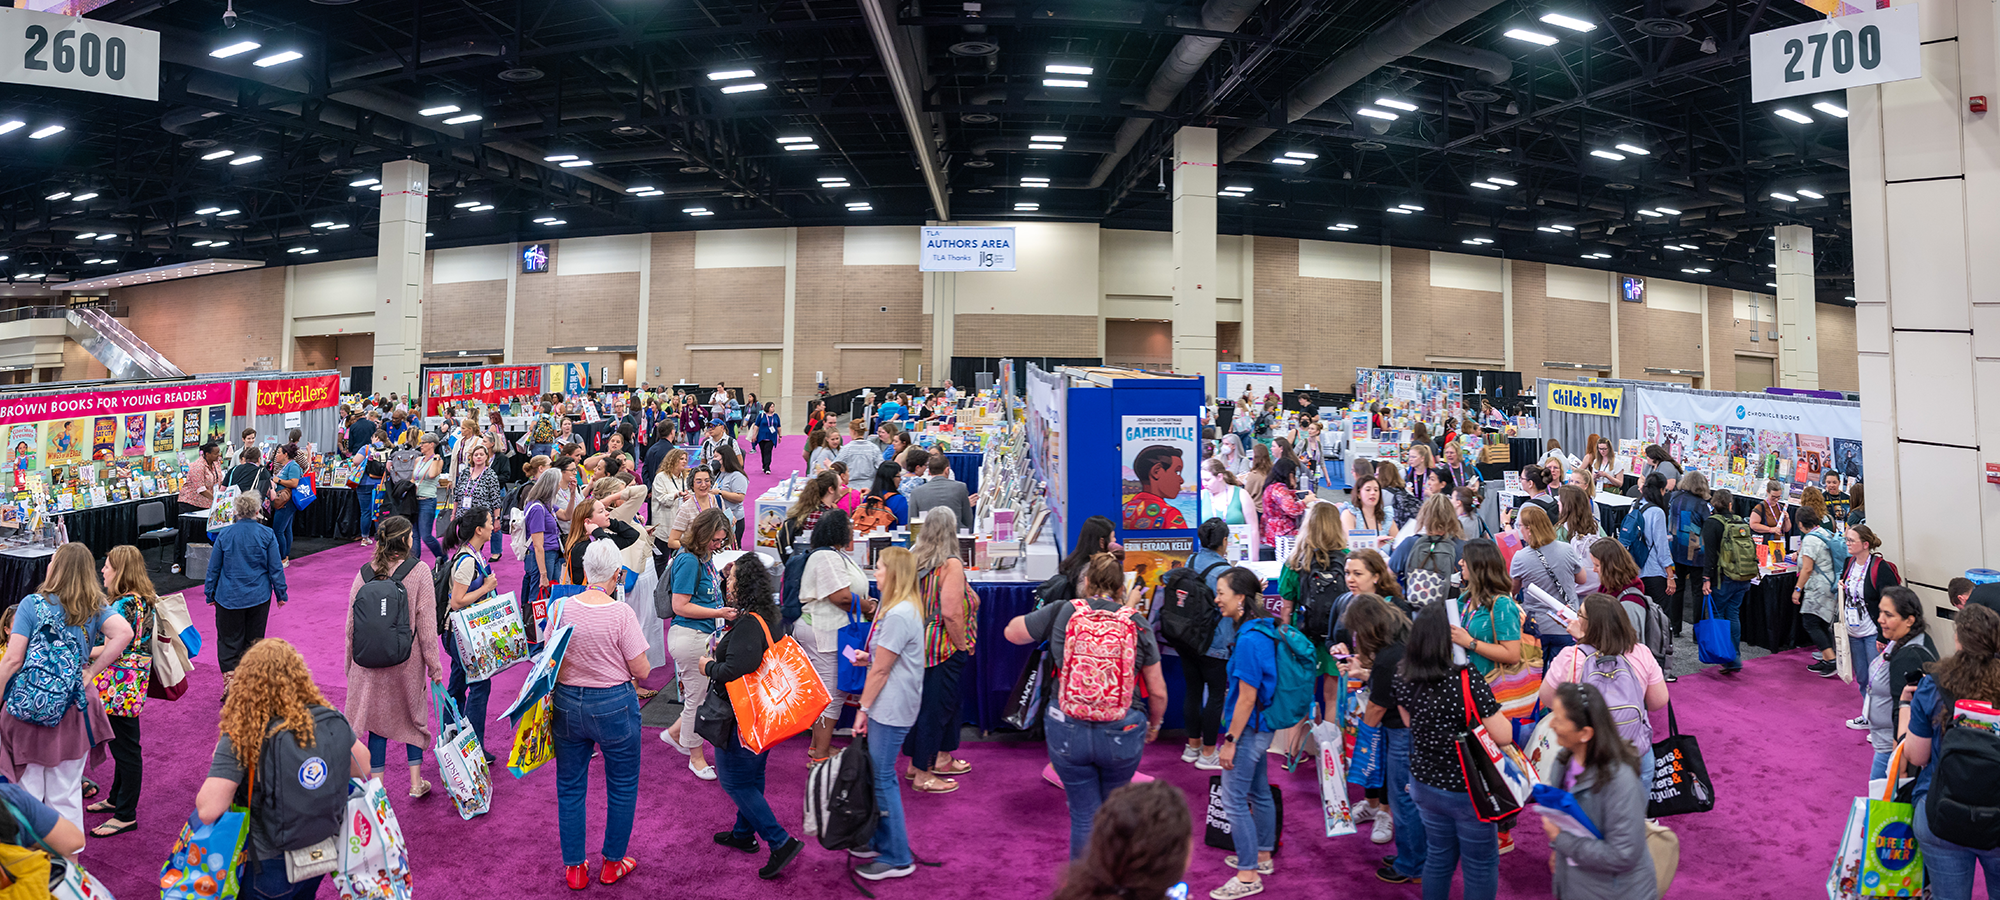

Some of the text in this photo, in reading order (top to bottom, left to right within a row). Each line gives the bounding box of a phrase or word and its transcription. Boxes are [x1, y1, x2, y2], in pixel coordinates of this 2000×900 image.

[24, 24, 126, 80] 2600
[1784, 24, 1881, 83] 2700
[927, 240, 1010, 248] AUTHORS AREA
[979, 251, 994, 268] jlg
[0, 390, 207, 418] BROWN BOOKS FOR YOUNG READERS
[257, 386, 328, 409] torytellers
[1553, 389, 1618, 414] Child's Play
[1747, 411, 1779, 419] CHRONICLE
[1126, 427, 1194, 442] GAMERVILLE
[1662, 424, 1689, 436] TOGETHER
[1840, 442, 1860, 451] COMET
[1172, 542, 1192, 550] KELLY
[1019, 670, 1038, 706] MACKIN
[461, 737, 479, 758] EVERY
[444, 752, 469, 794] capstone
[1207, 804, 1226, 819] Rea
[1206, 815, 1232, 834] Peng
[1876, 835, 1918, 850] DIFFERENCE
[1881, 848, 1910, 860] MAKER
